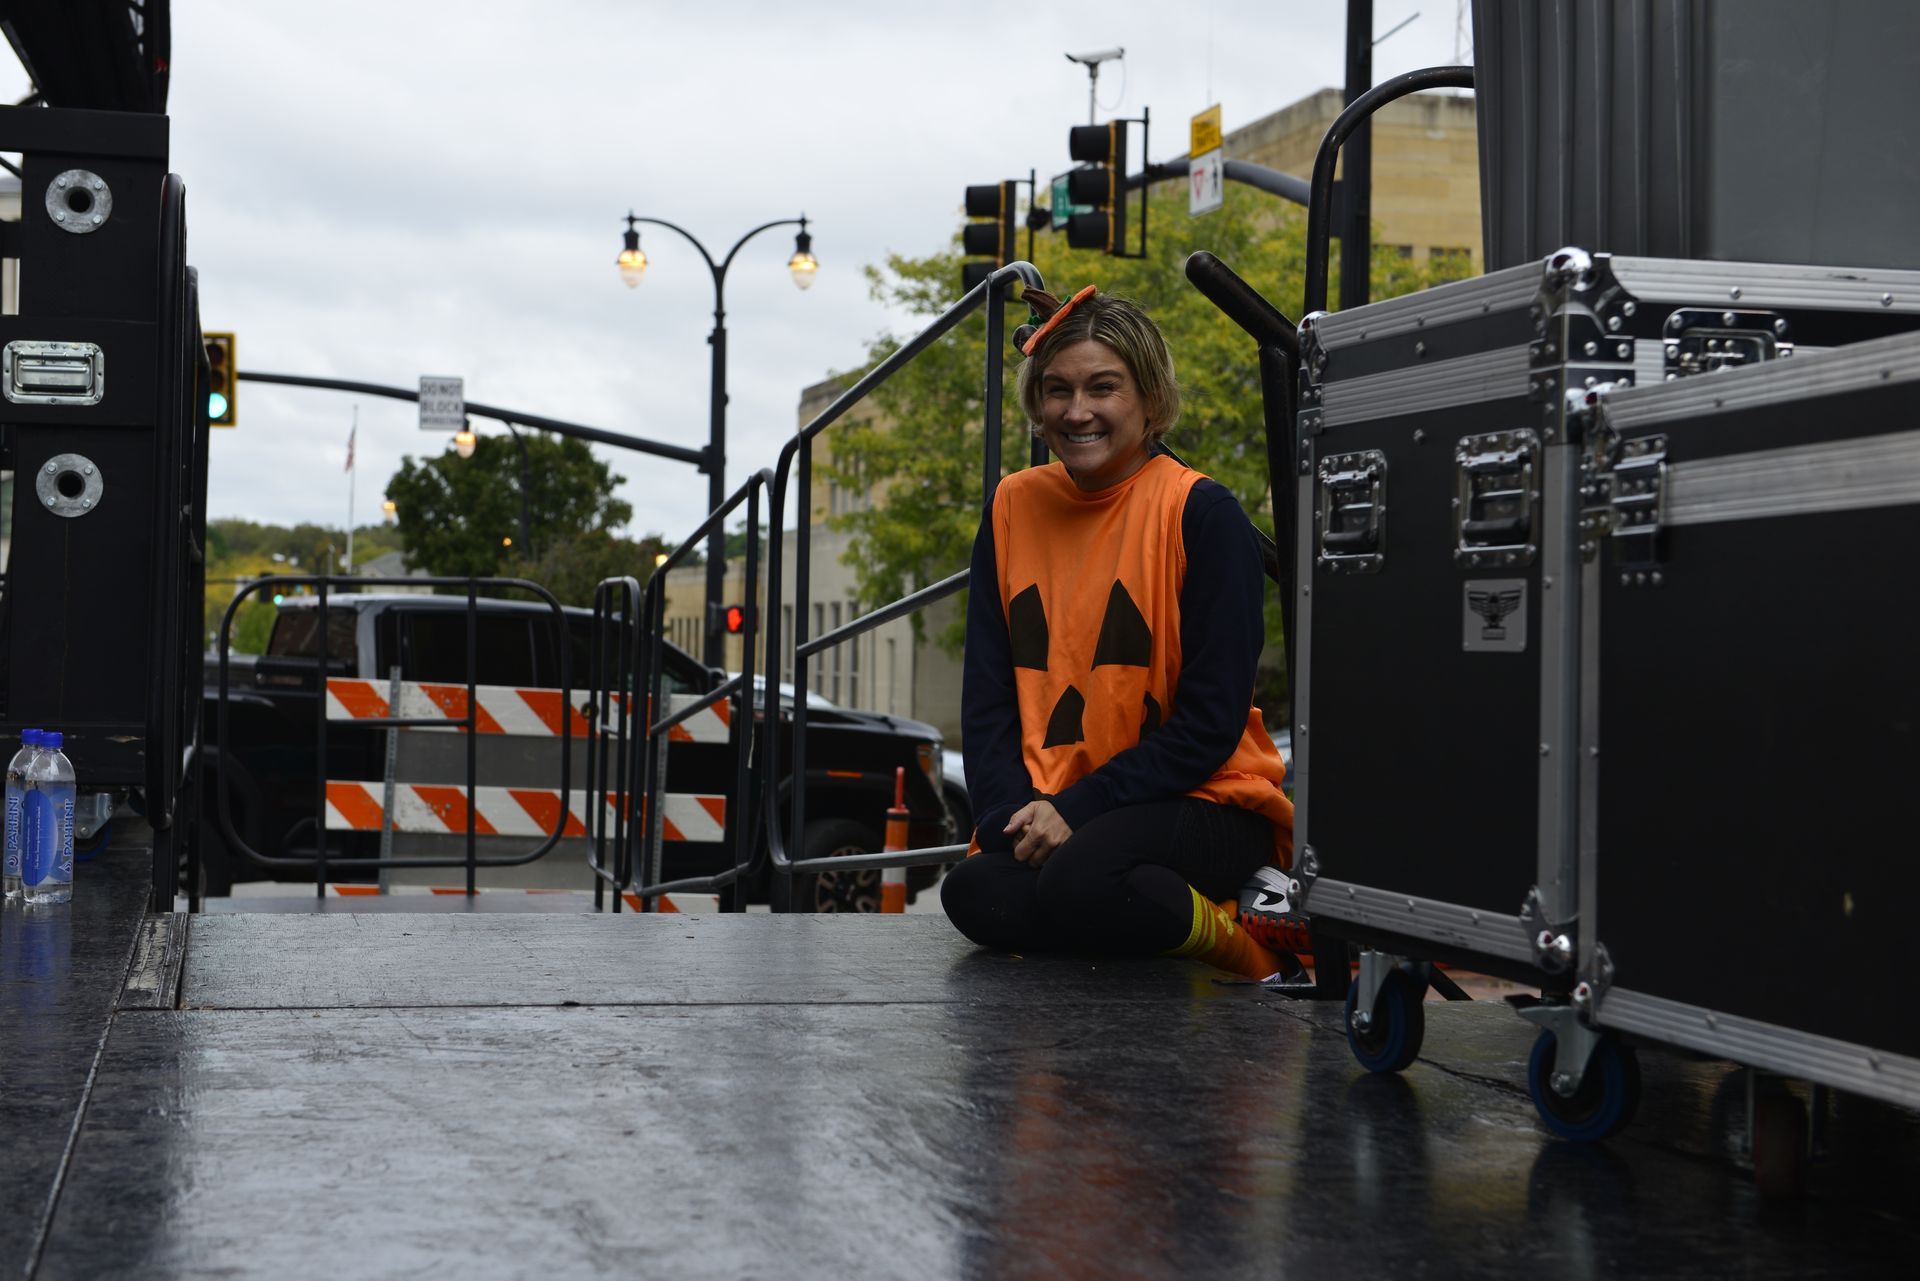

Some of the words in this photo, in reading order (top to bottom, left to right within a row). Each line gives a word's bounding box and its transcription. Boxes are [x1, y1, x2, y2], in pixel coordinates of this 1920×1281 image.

[421, 382, 437, 396] DO
[439, 383, 462, 397] NOT
[422, 400, 461, 414] BLOCK
